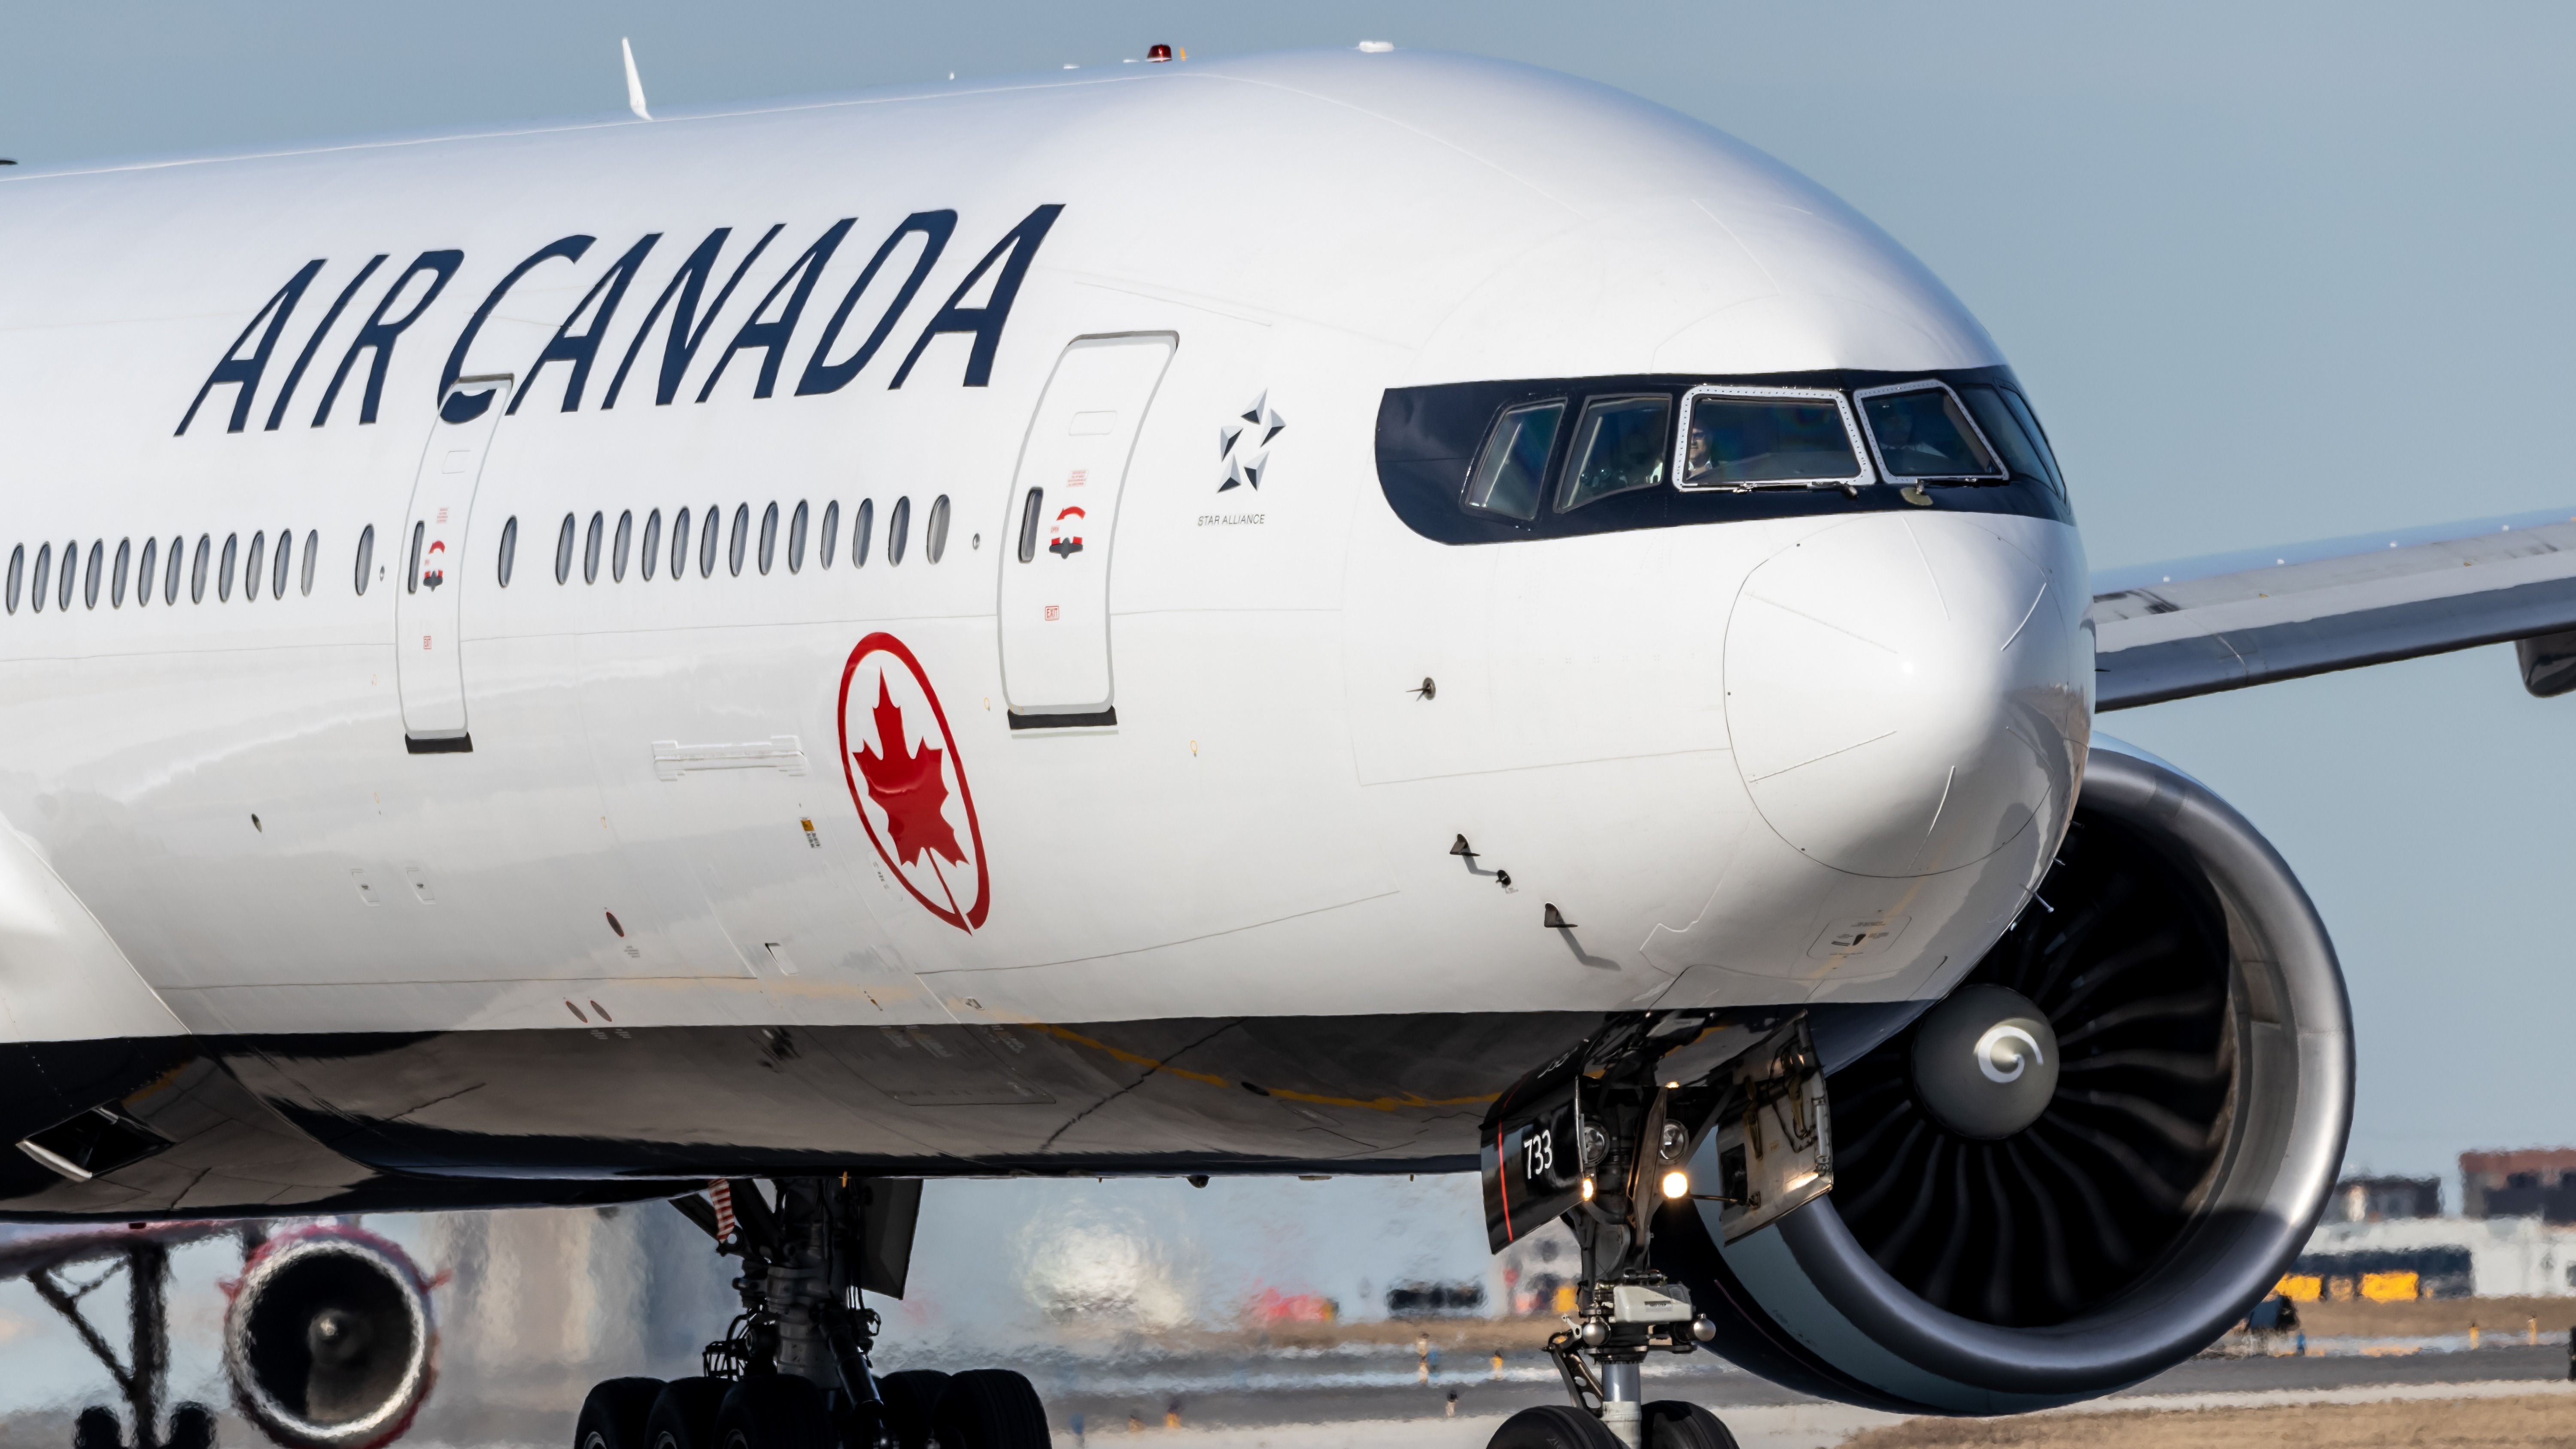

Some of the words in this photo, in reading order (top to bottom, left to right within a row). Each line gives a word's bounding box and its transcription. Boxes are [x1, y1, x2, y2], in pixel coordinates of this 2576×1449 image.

[175, 249, 465, 434] AIR
[437, 204, 1065, 423] CANADA
[1198, 516, 1220, 526] STAR
[1222, 514, 1265, 525] ALLIANCE
[1047, 608, 1058, 618] EXIT
[1524, 1129, 1552, 1179] 733
